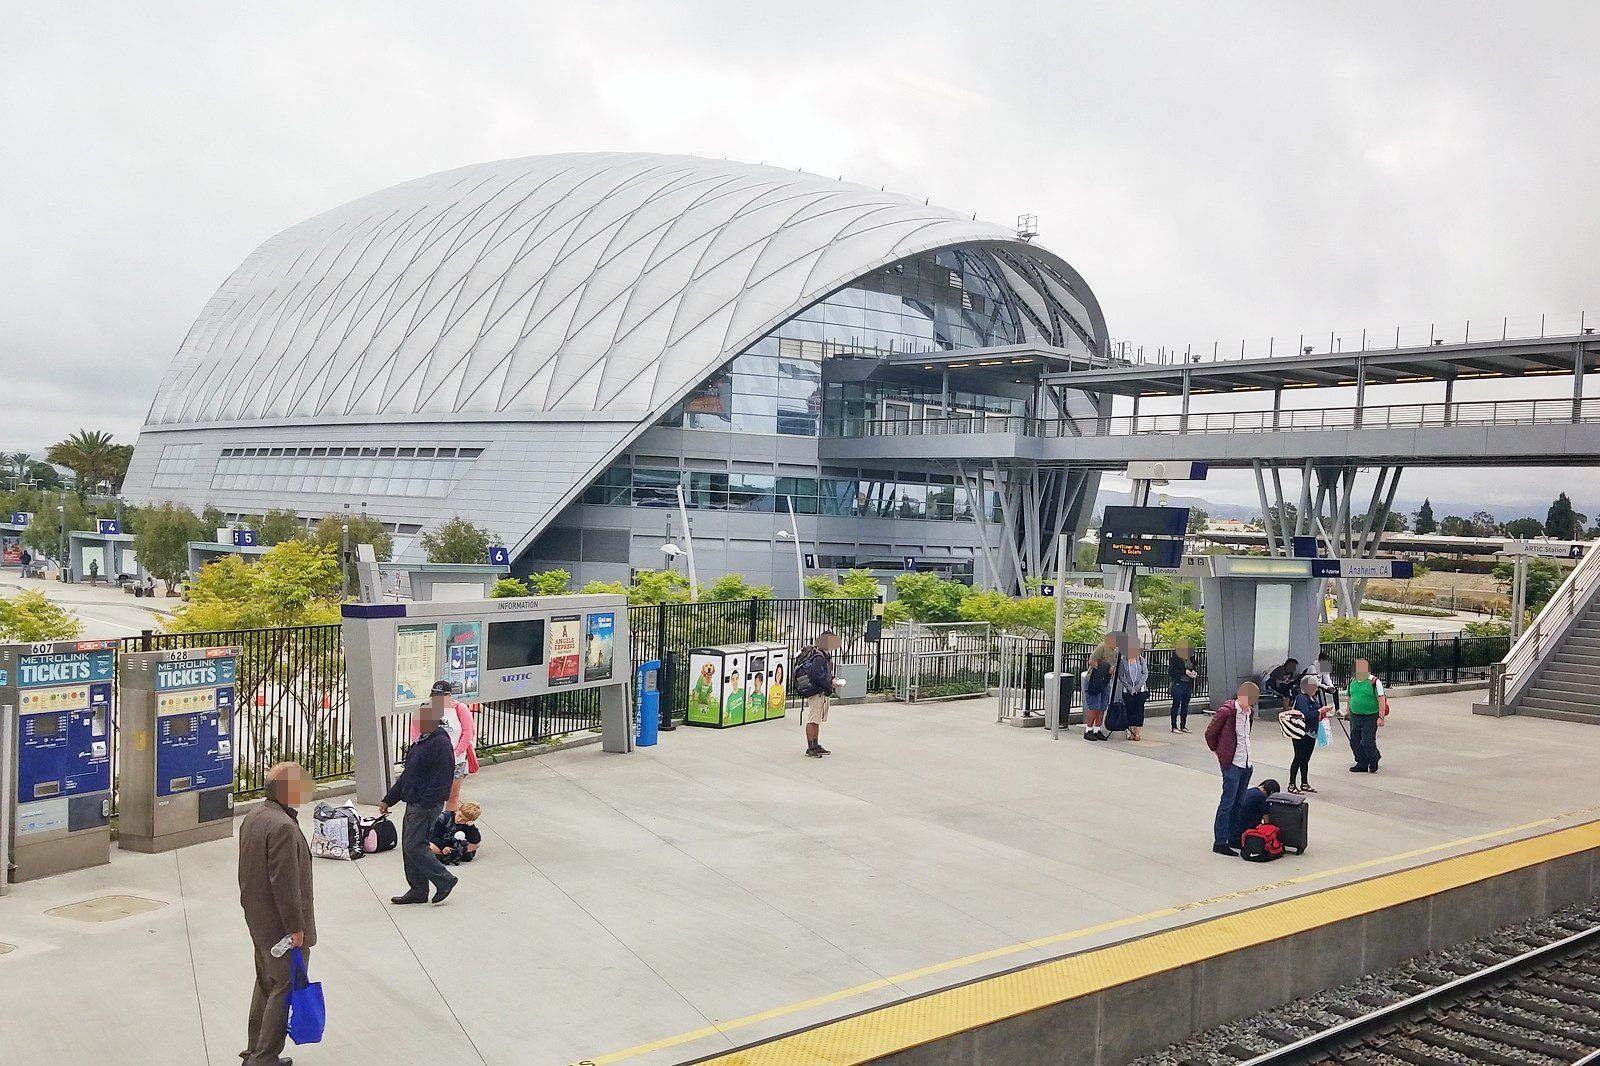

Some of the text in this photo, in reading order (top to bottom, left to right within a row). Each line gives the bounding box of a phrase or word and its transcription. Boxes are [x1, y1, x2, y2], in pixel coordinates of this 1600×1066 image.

[18, 514, 24, 522] 3
[108, 522, 116, 532] 4
[244, 532, 252, 544] 5
[496, 550, 504, 562] 6
[807, 556, 812, 566] 7
[907, 559, 913, 568] 7
[1380, 566, 1388, 574] CA
[1066, 590, 1093, 598] Emergency
[498, 601, 538, 610] INFORMATION
[32, 644, 52, 653] 607
[21, 652, 90, 664] METROLINK
[170, 651, 188, 660] 628
[158, 659, 216, 671] METROLINK
[20, 662, 90, 683] TICKETS
[157, 667, 217, 688] TICKETS
[499, 673, 532, 683] ARTIC
